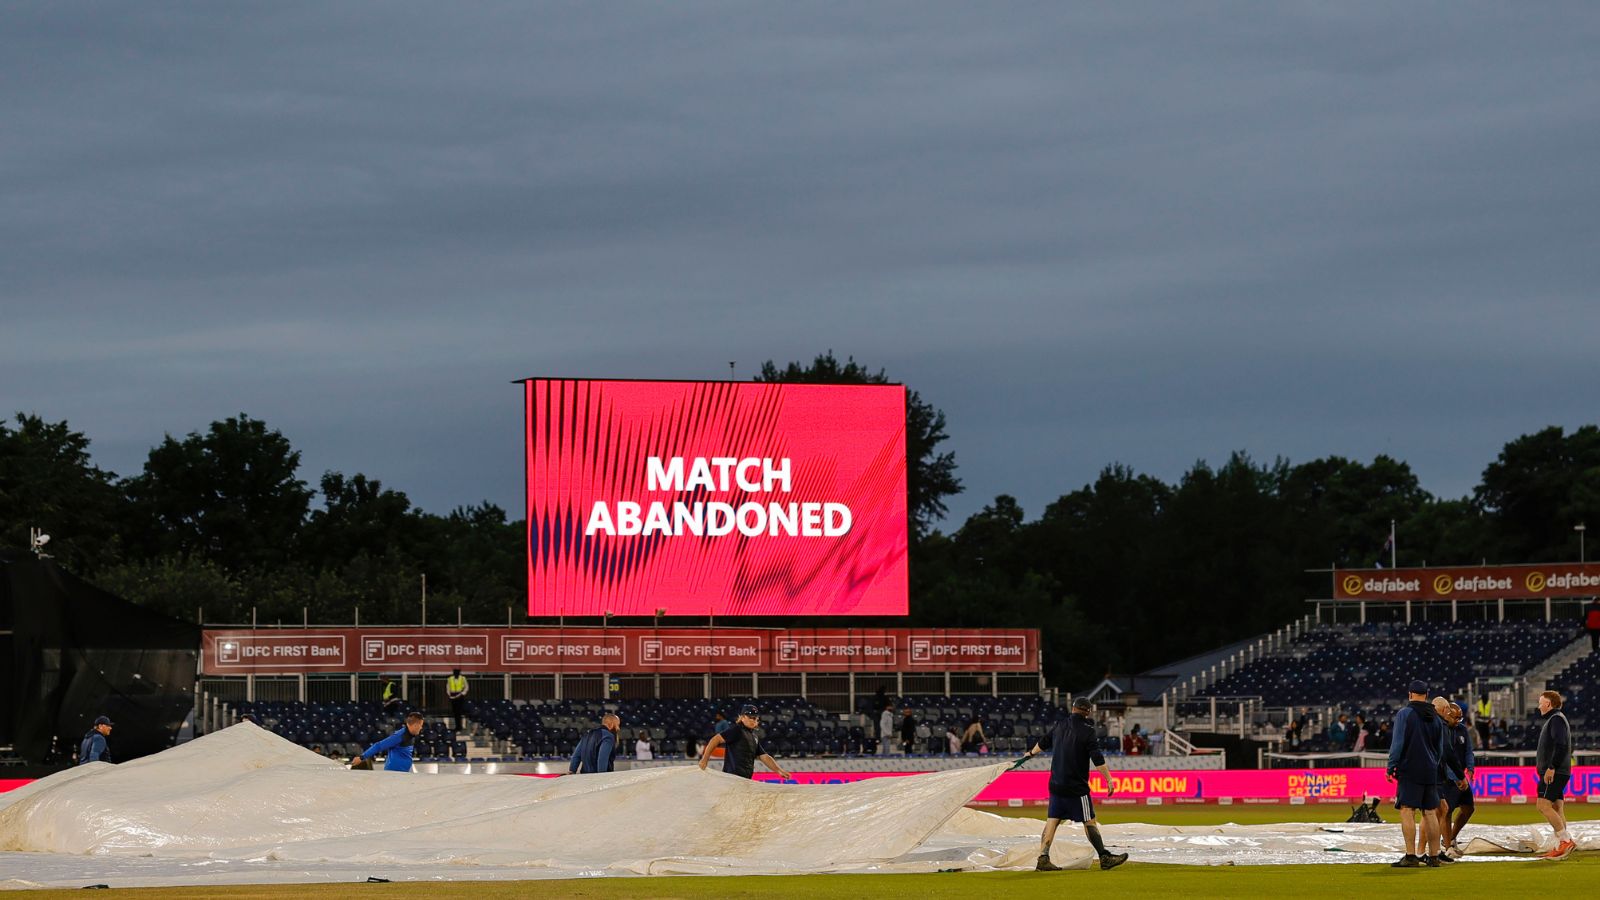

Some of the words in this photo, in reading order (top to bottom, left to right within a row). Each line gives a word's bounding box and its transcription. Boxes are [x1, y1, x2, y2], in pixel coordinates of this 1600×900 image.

[646, 456, 791, 492] MATCH
[585, 500, 853, 537] ABANDONED
[1364, 578, 1420, 594] dafabet
[1454, 576, 1512, 592] dafabet
[1546, 572, 1600, 589] dafabe
[242, 645, 270, 657] IDFC
[273, 645, 308, 656] FIRST
[311, 645, 340, 656] Bank
[387, 644, 415, 656] IDFC
[418, 644, 451, 656] FIRST
[454, 644, 483, 656] Bank
[526, 645, 554, 656] IDFC
[557, 645, 590, 656] FIRST
[592, 645, 621, 656] Bank
[664, 645, 691, 656] IDFC
[694, 645, 726, 656] FIRST
[729, 645, 756, 656] Bank
[800, 645, 827, 656] IDFC
[829, 645, 861, 656] FIRST
[863, 645, 891, 656] Bank
[932, 644, 958, 656] IDFC
[960, 644, 992, 656] FIRST
[994, 644, 1021, 656] Bank
[1088, 777, 1145, 793] NLOAD
[1150, 777, 1187, 793] NOW
[1288, 774, 1347, 787] DYNAMOS
[1468, 773, 1523, 796] WER
[1289, 784, 1347, 797] CRICKET
